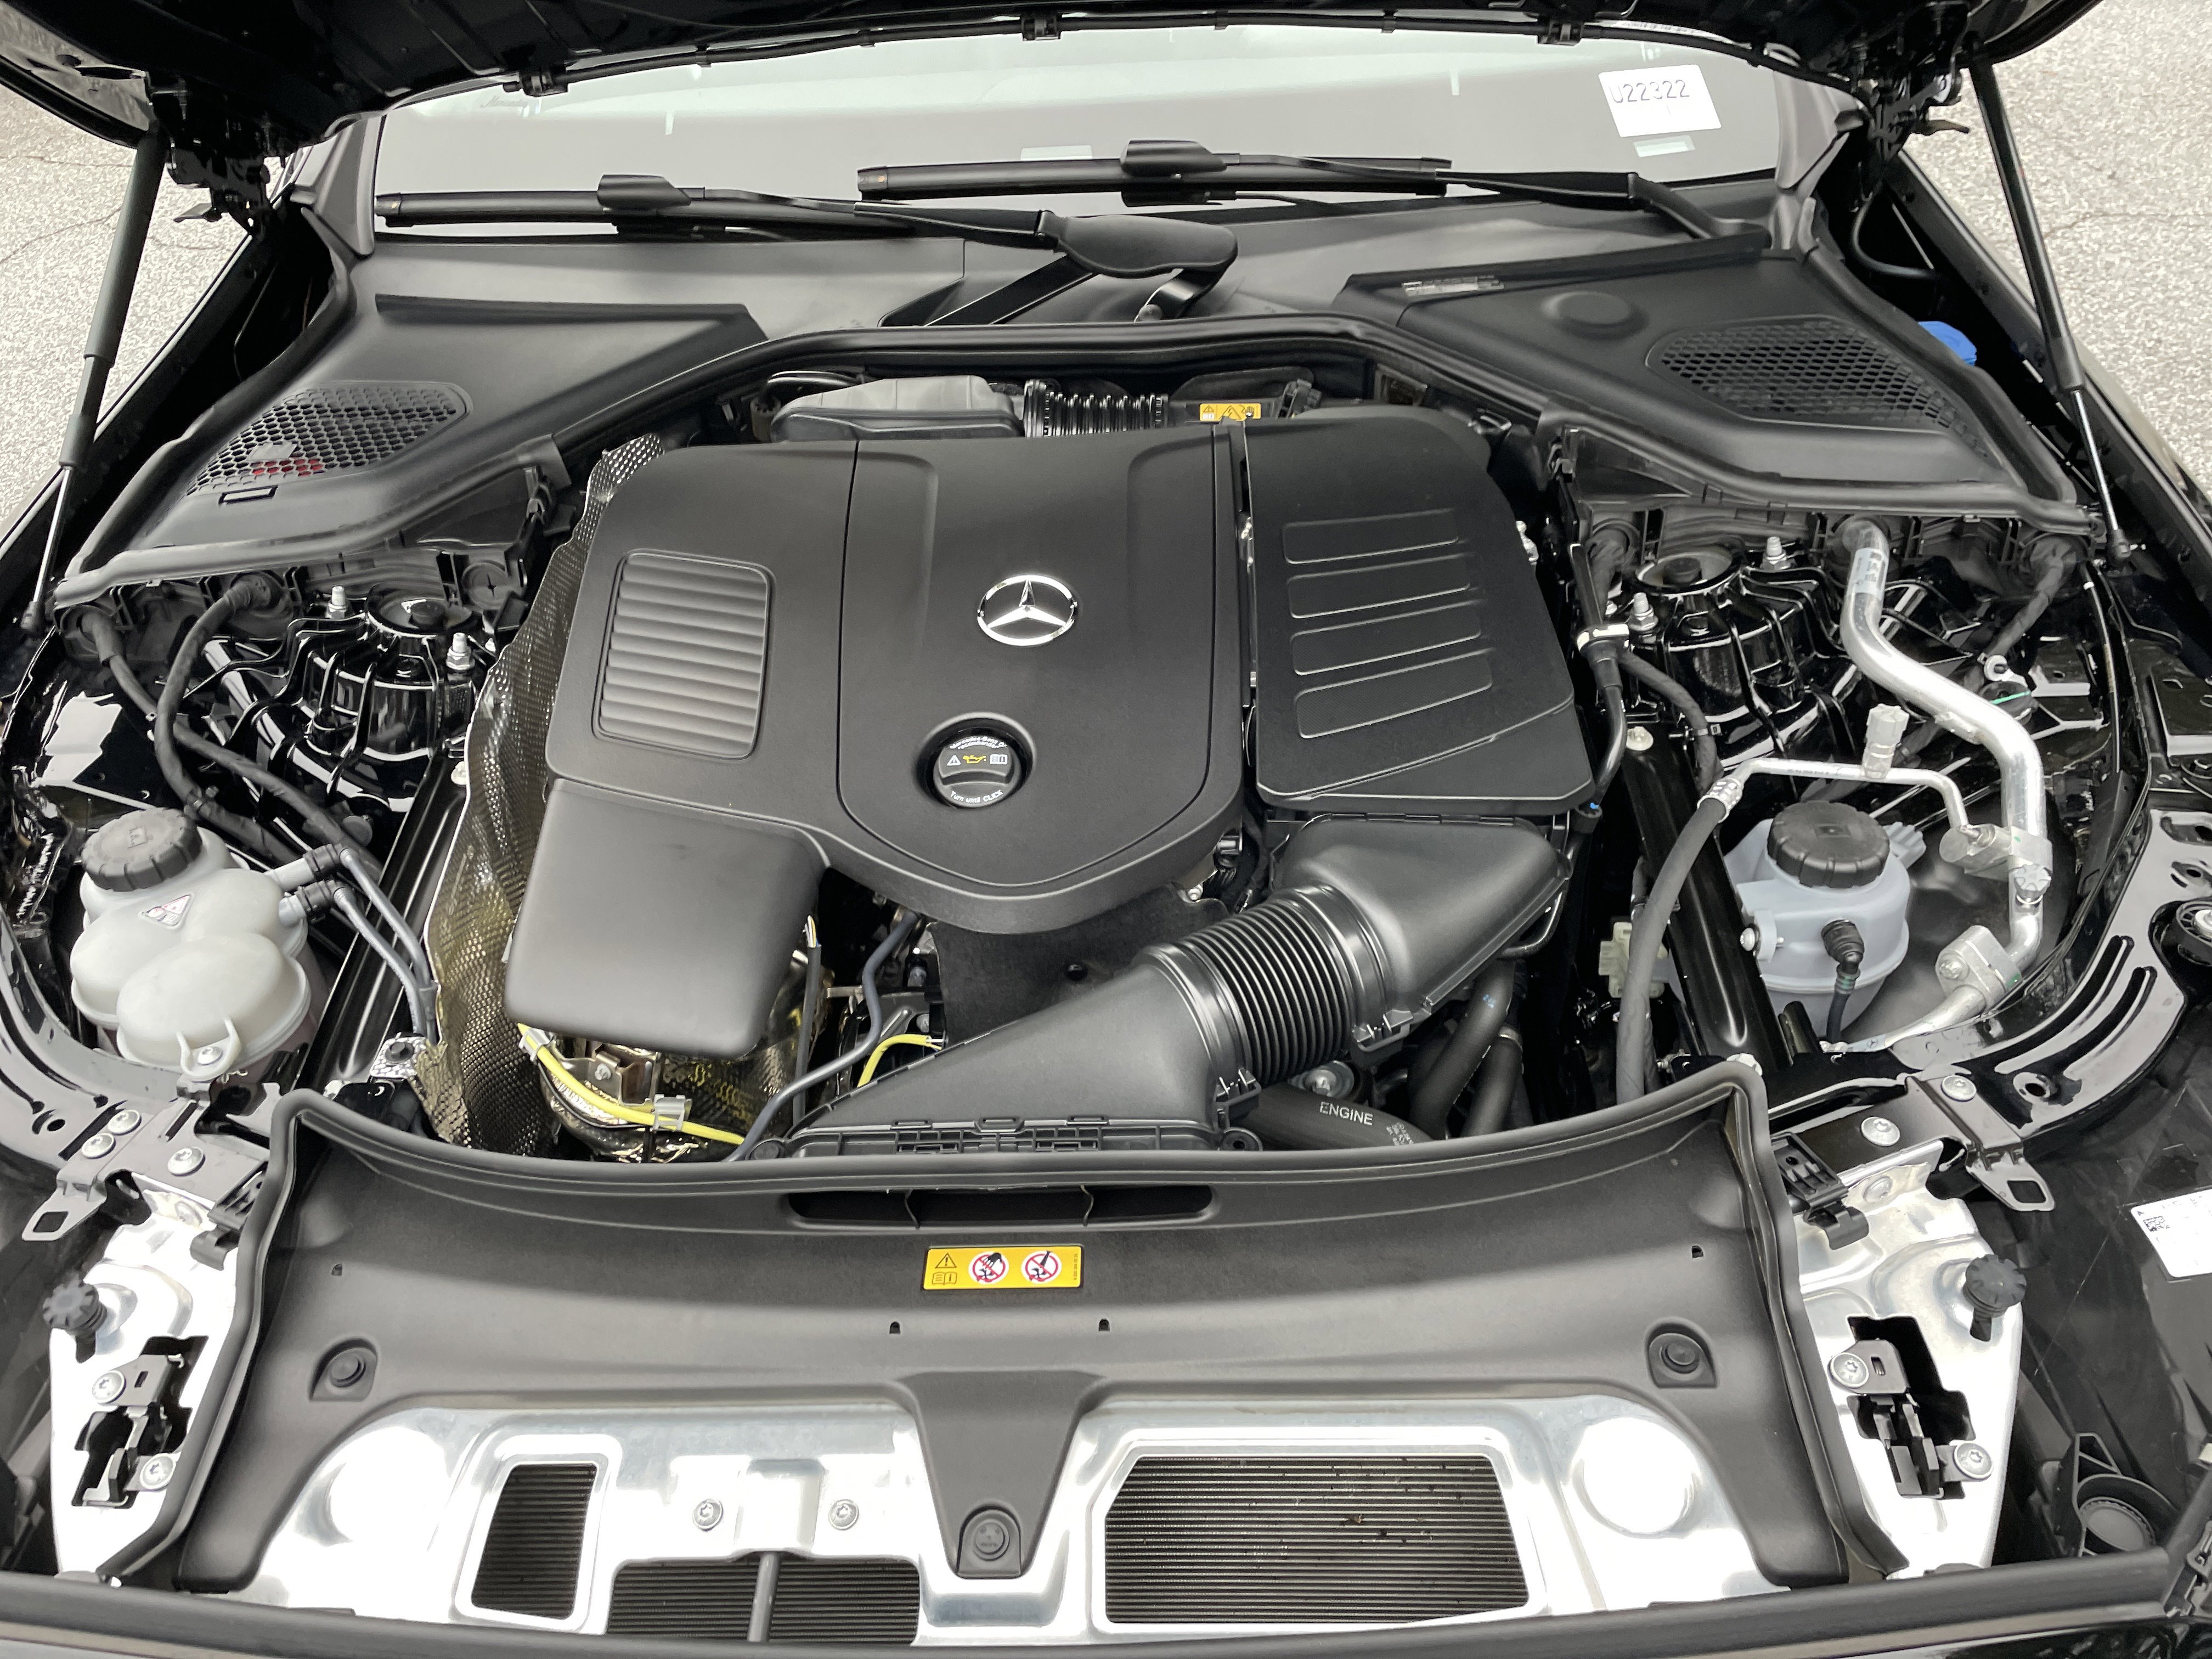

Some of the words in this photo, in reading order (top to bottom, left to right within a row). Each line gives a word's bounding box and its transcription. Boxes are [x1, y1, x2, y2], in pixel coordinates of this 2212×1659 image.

[1609, 80, 1689, 103] U22322
[950, 791, 964, 802] Turn
[983, 789, 1003, 802] CLICK
[1319, 1101, 1374, 1126] ENGINE
